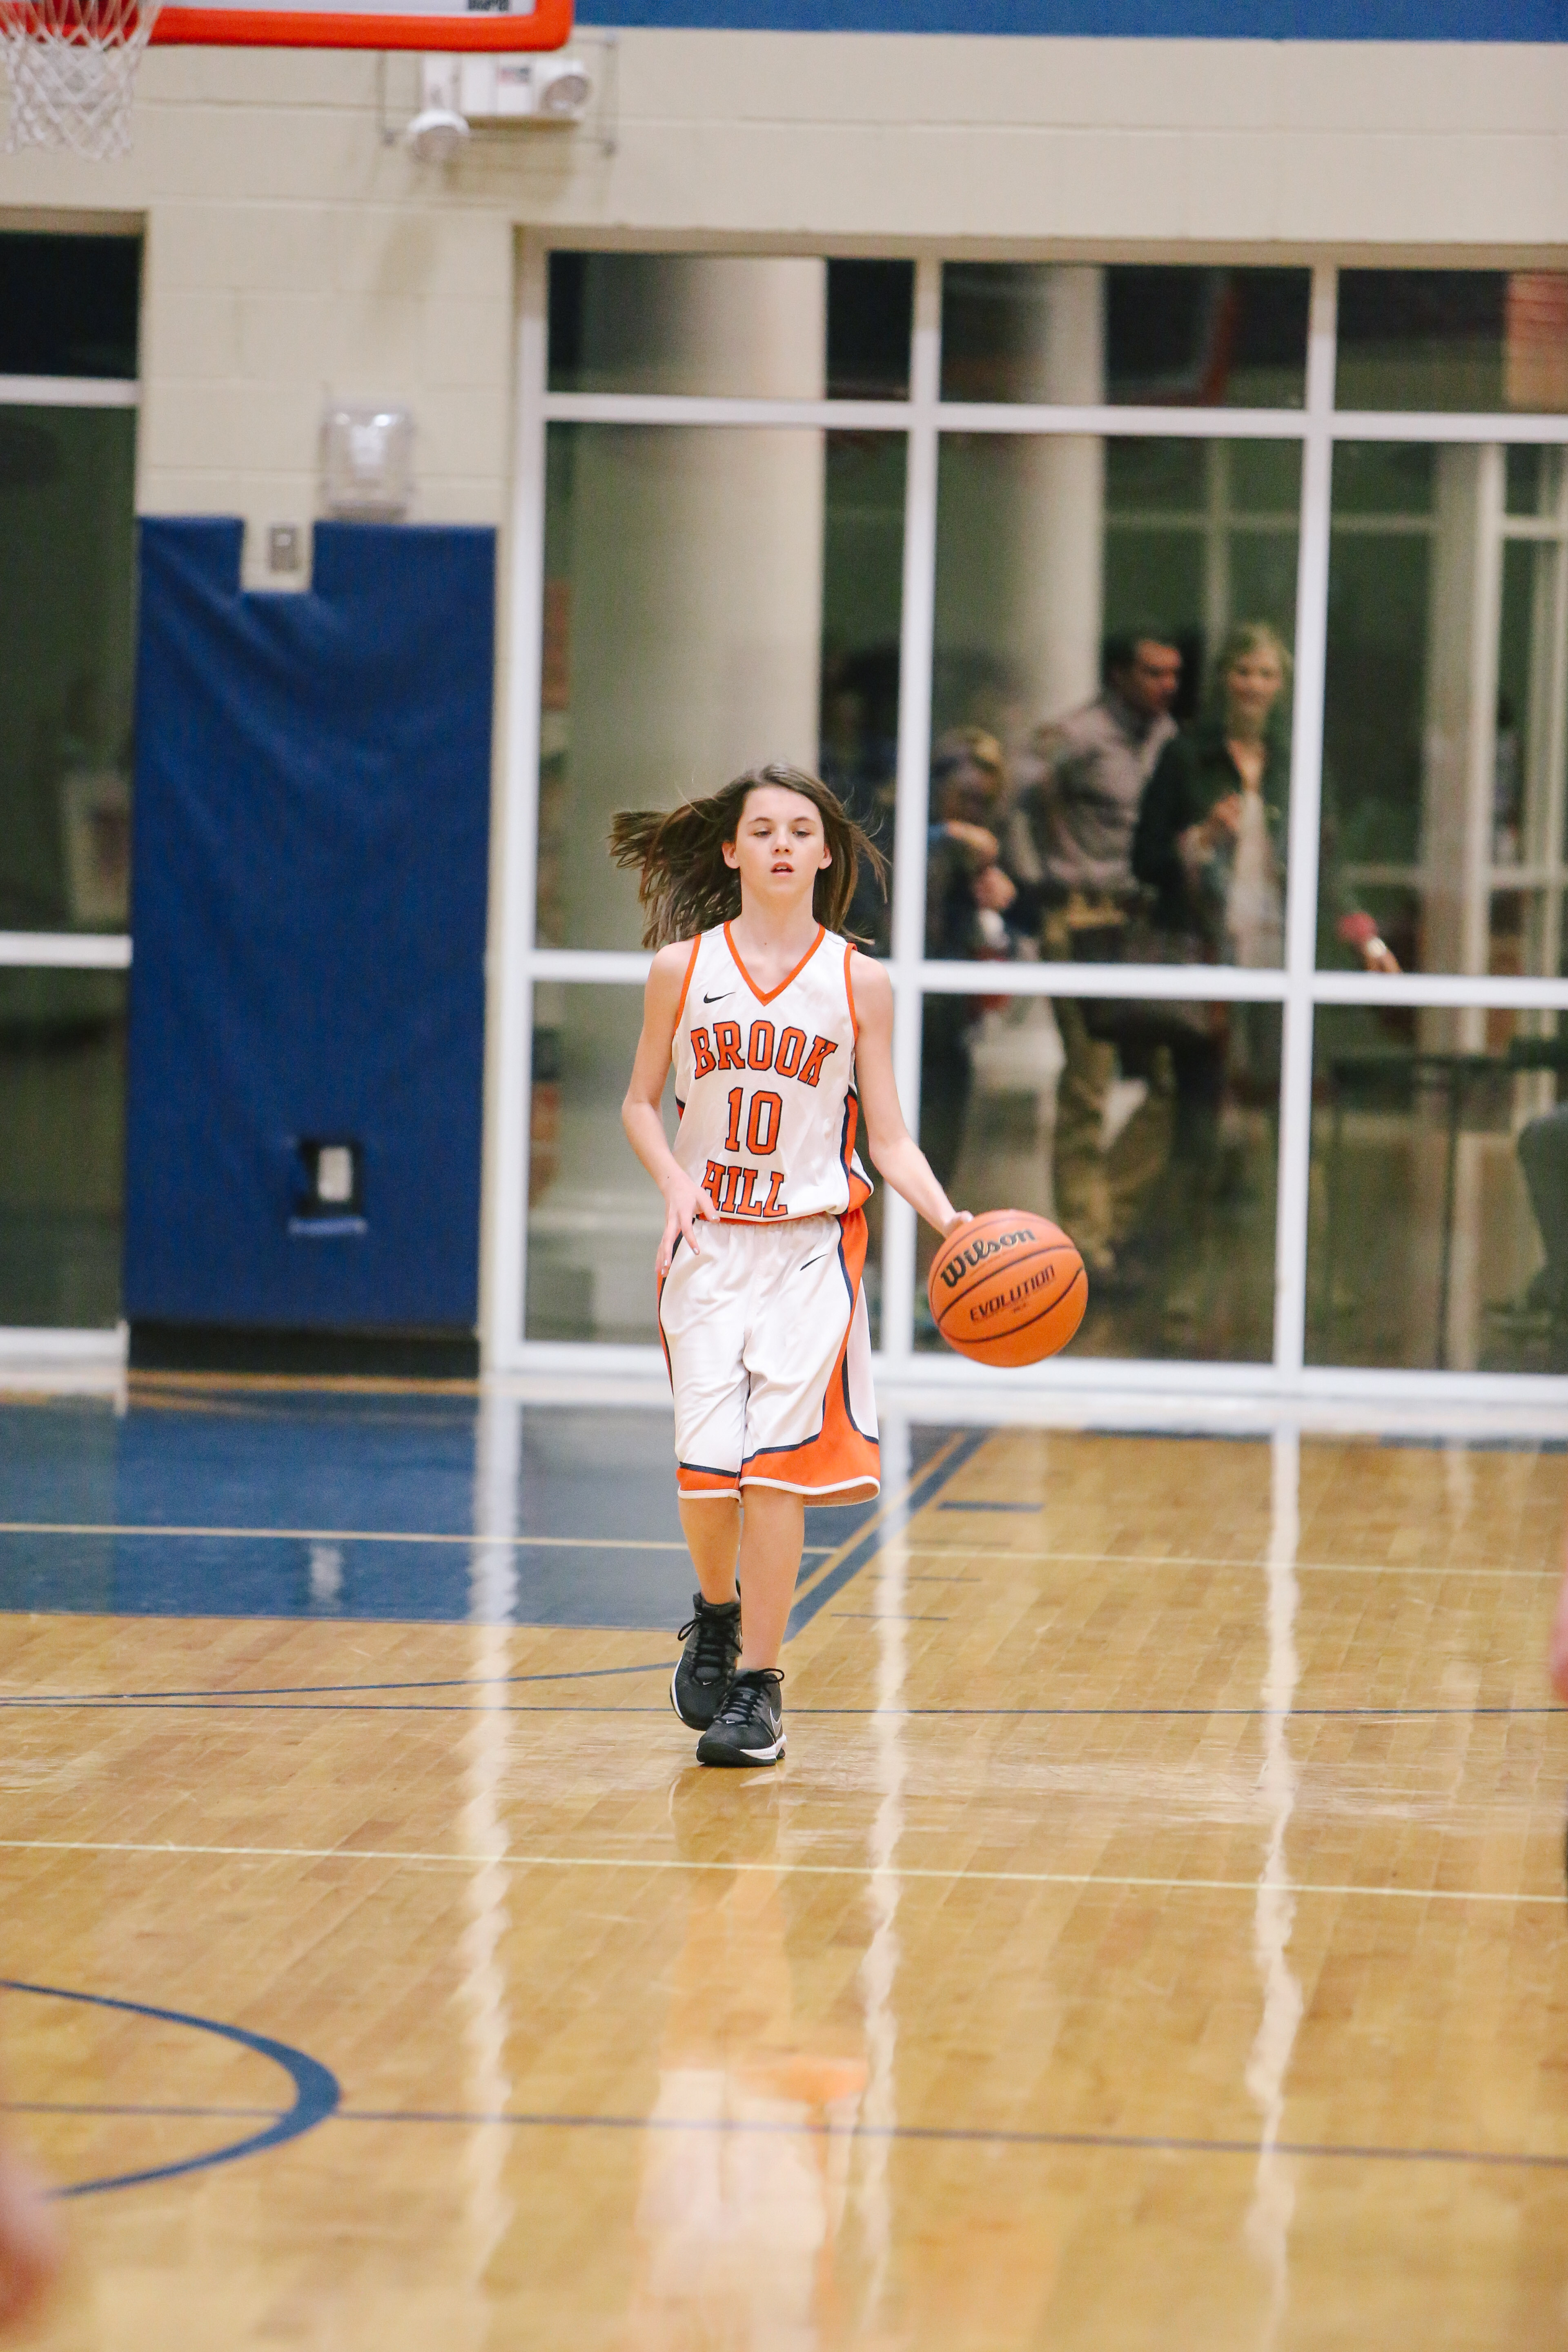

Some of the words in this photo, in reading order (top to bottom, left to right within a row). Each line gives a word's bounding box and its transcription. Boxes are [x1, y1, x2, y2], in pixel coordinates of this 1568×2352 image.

[690, 1020, 838, 1088] BROOK
[724, 1087, 783, 1155] 10
[701, 1159, 788, 1218] HILL
[940, 1228, 1038, 1288] Wilson
[969, 1264, 1055, 1322] EVOLUTION
